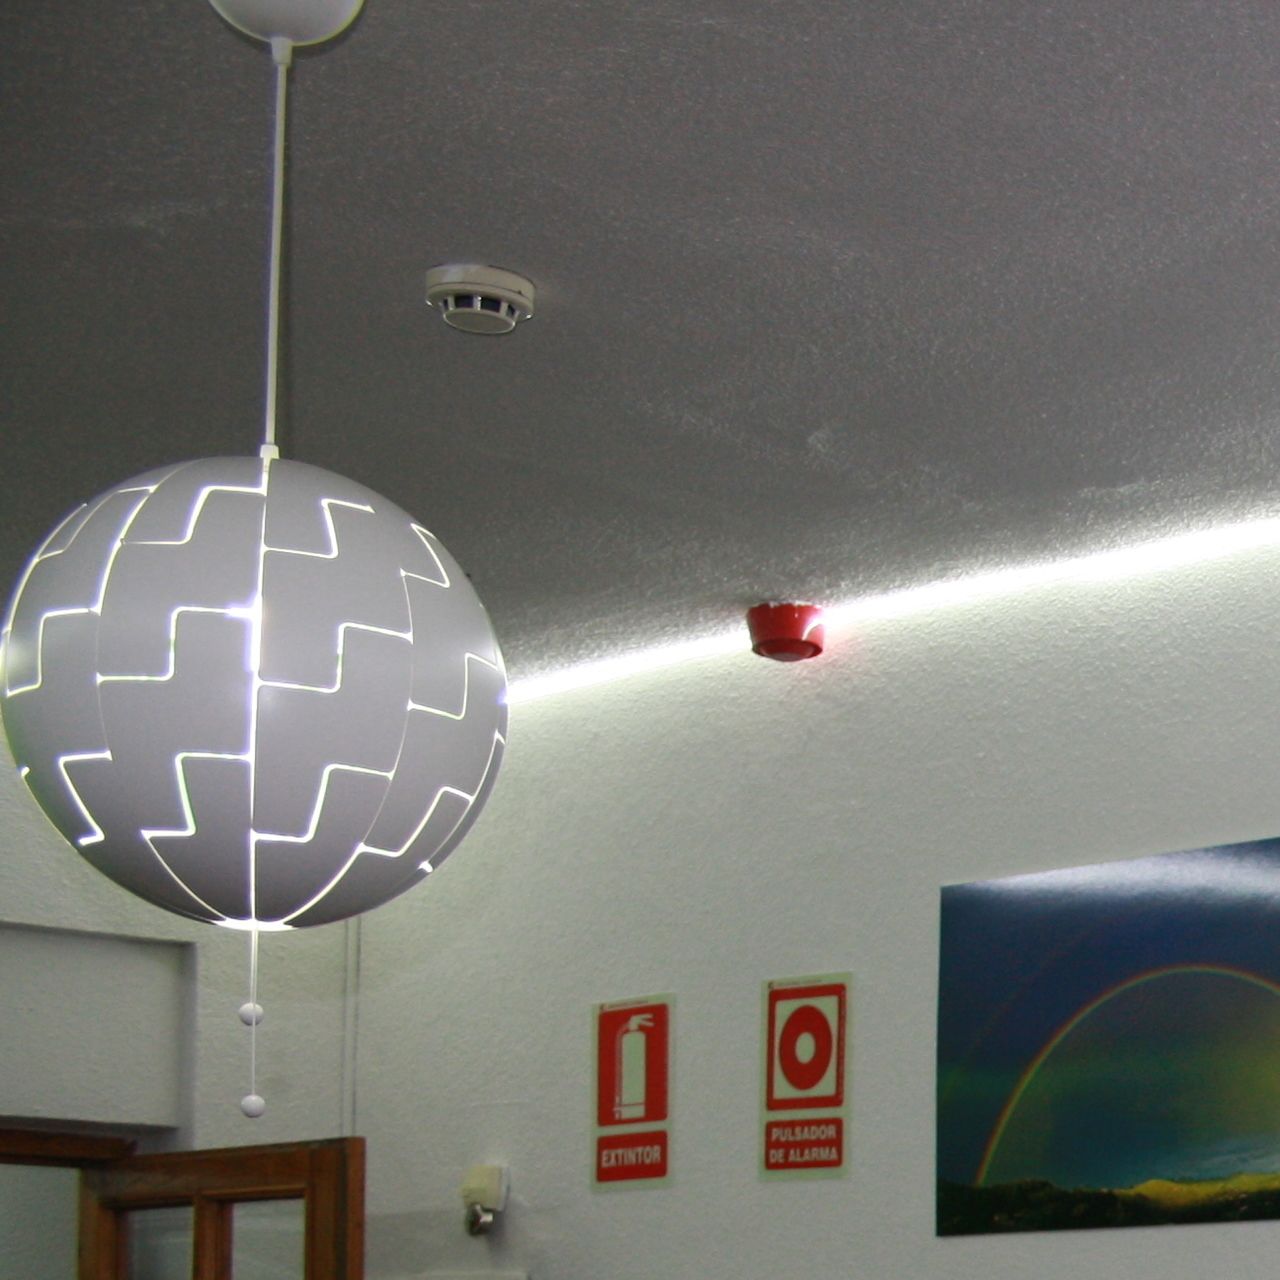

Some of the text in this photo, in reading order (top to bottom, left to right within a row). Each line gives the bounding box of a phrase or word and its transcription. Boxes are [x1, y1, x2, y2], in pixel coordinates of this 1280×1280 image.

[771, 1125, 836, 1142] PULSADOR
[601, 1146, 661, 1167] EXTINTOR
[769, 1147, 838, 1163] DE ALARMA
